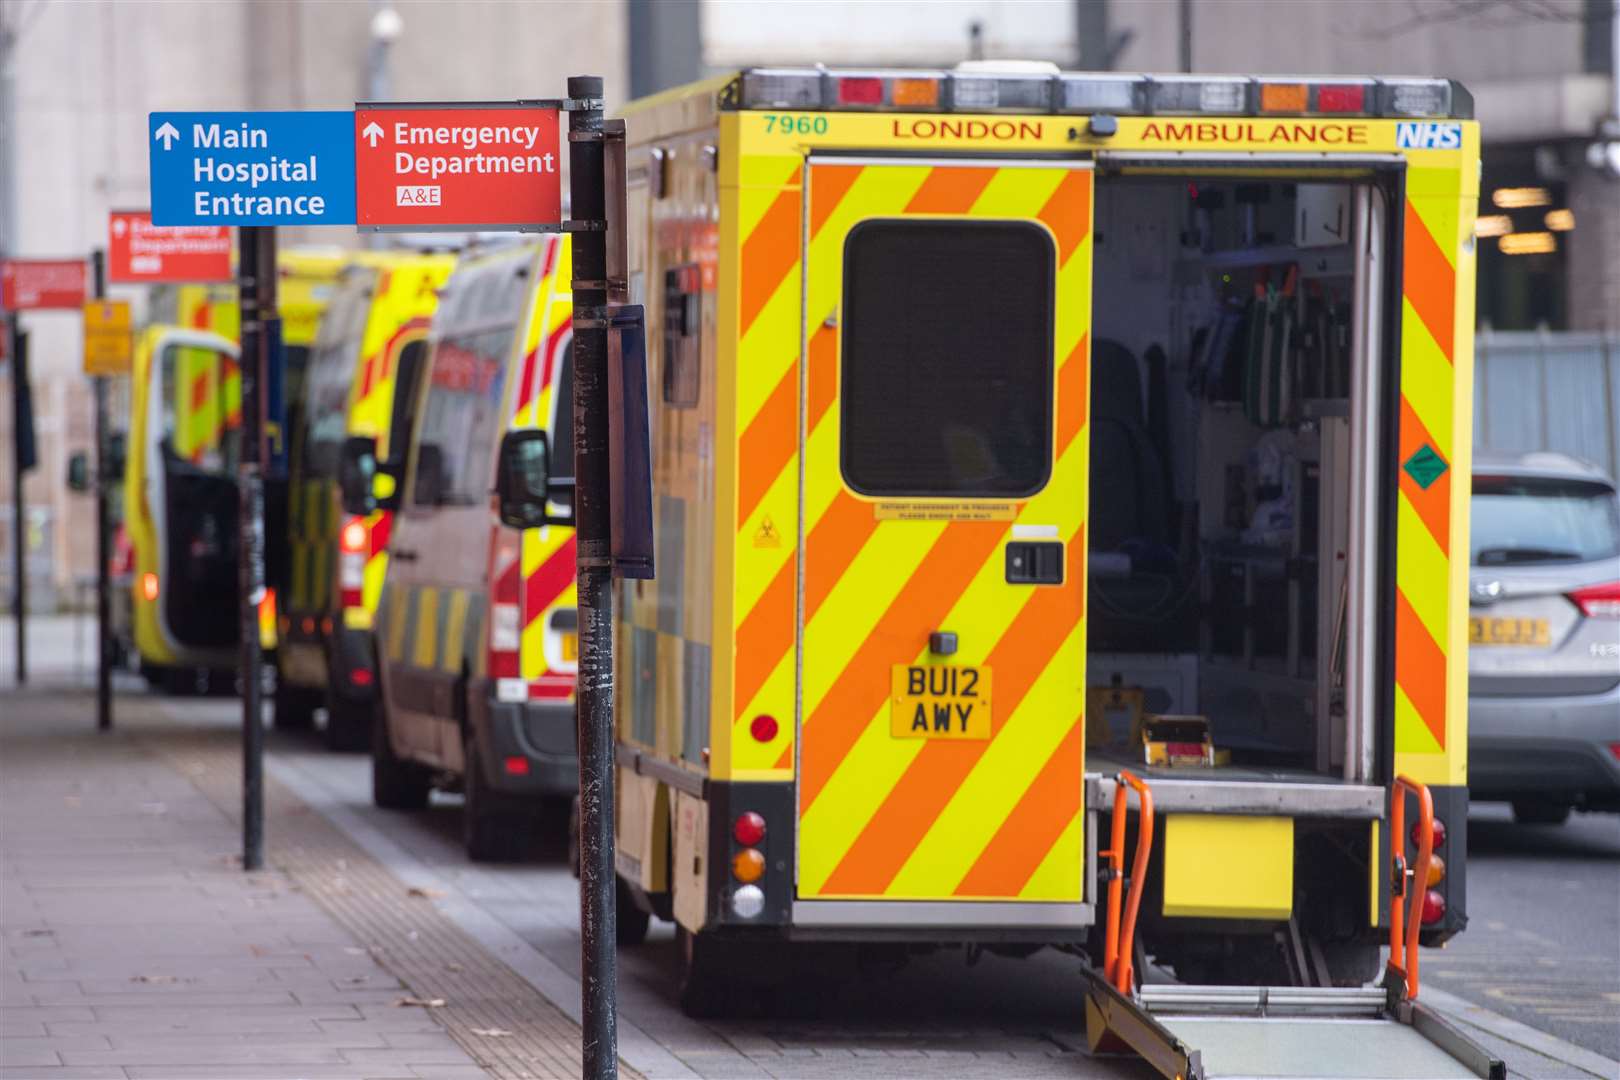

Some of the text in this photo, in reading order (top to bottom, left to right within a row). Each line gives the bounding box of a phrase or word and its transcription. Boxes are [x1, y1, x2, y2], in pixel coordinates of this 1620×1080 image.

[194, 123, 267, 148] Main
[394, 122, 540, 150] Emergency
[763, 115, 828, 135] 7960
[892, 119, 1368, 144] LONDON AMBULANCE
[1397, 121, 1461, 149] NHS
[194, 156, 317, 188] Hospital
[395, 152, 555, 180] Department
[195, 192, 325, 216] Entrance
[399, 187, 440, 204] A&E
[907, 667, 979, 697] BU12
[911, 703, 973, 732] AWY
